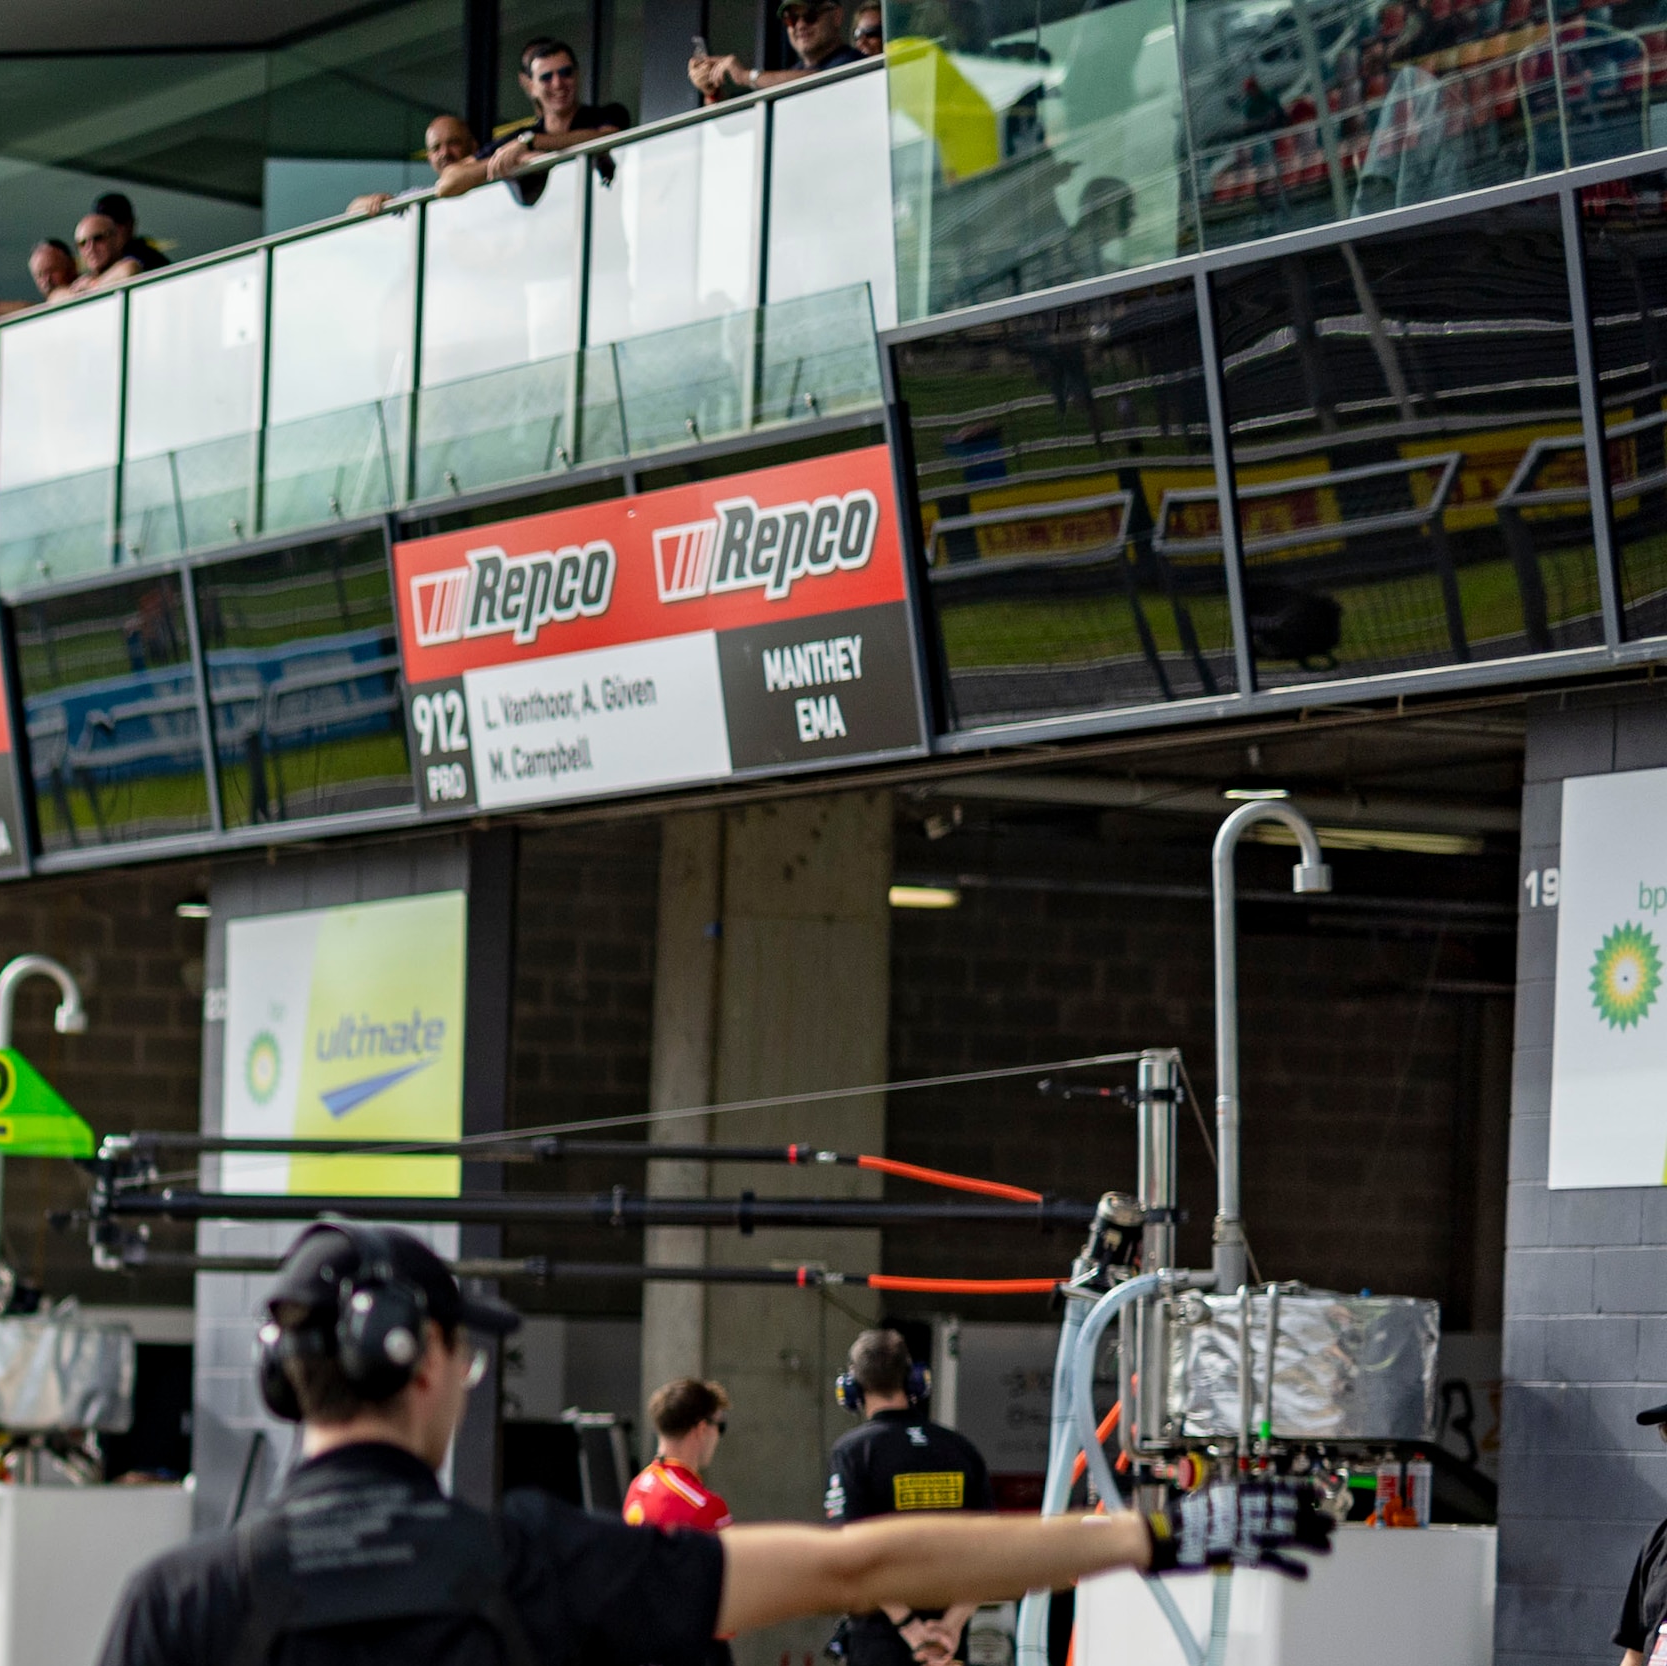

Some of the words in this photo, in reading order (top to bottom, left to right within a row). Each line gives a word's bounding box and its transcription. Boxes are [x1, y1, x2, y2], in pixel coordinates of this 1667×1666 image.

[468, 549, 614, 640] Repco
[713, 494, 875, 594] Repco
[763, 635, 863, 692] MANTHEY
[413, 690, 467, 755] 912
[795, 695, 847, 742] EMA
[427, 763, 467, 802] PRO
[512, 739, 592, 781] Campbell
[1525, 868, 1559, 907] 19
[1639, 880, 1667, 917] bp
[317, 1007, 445, 1062] ultimate
